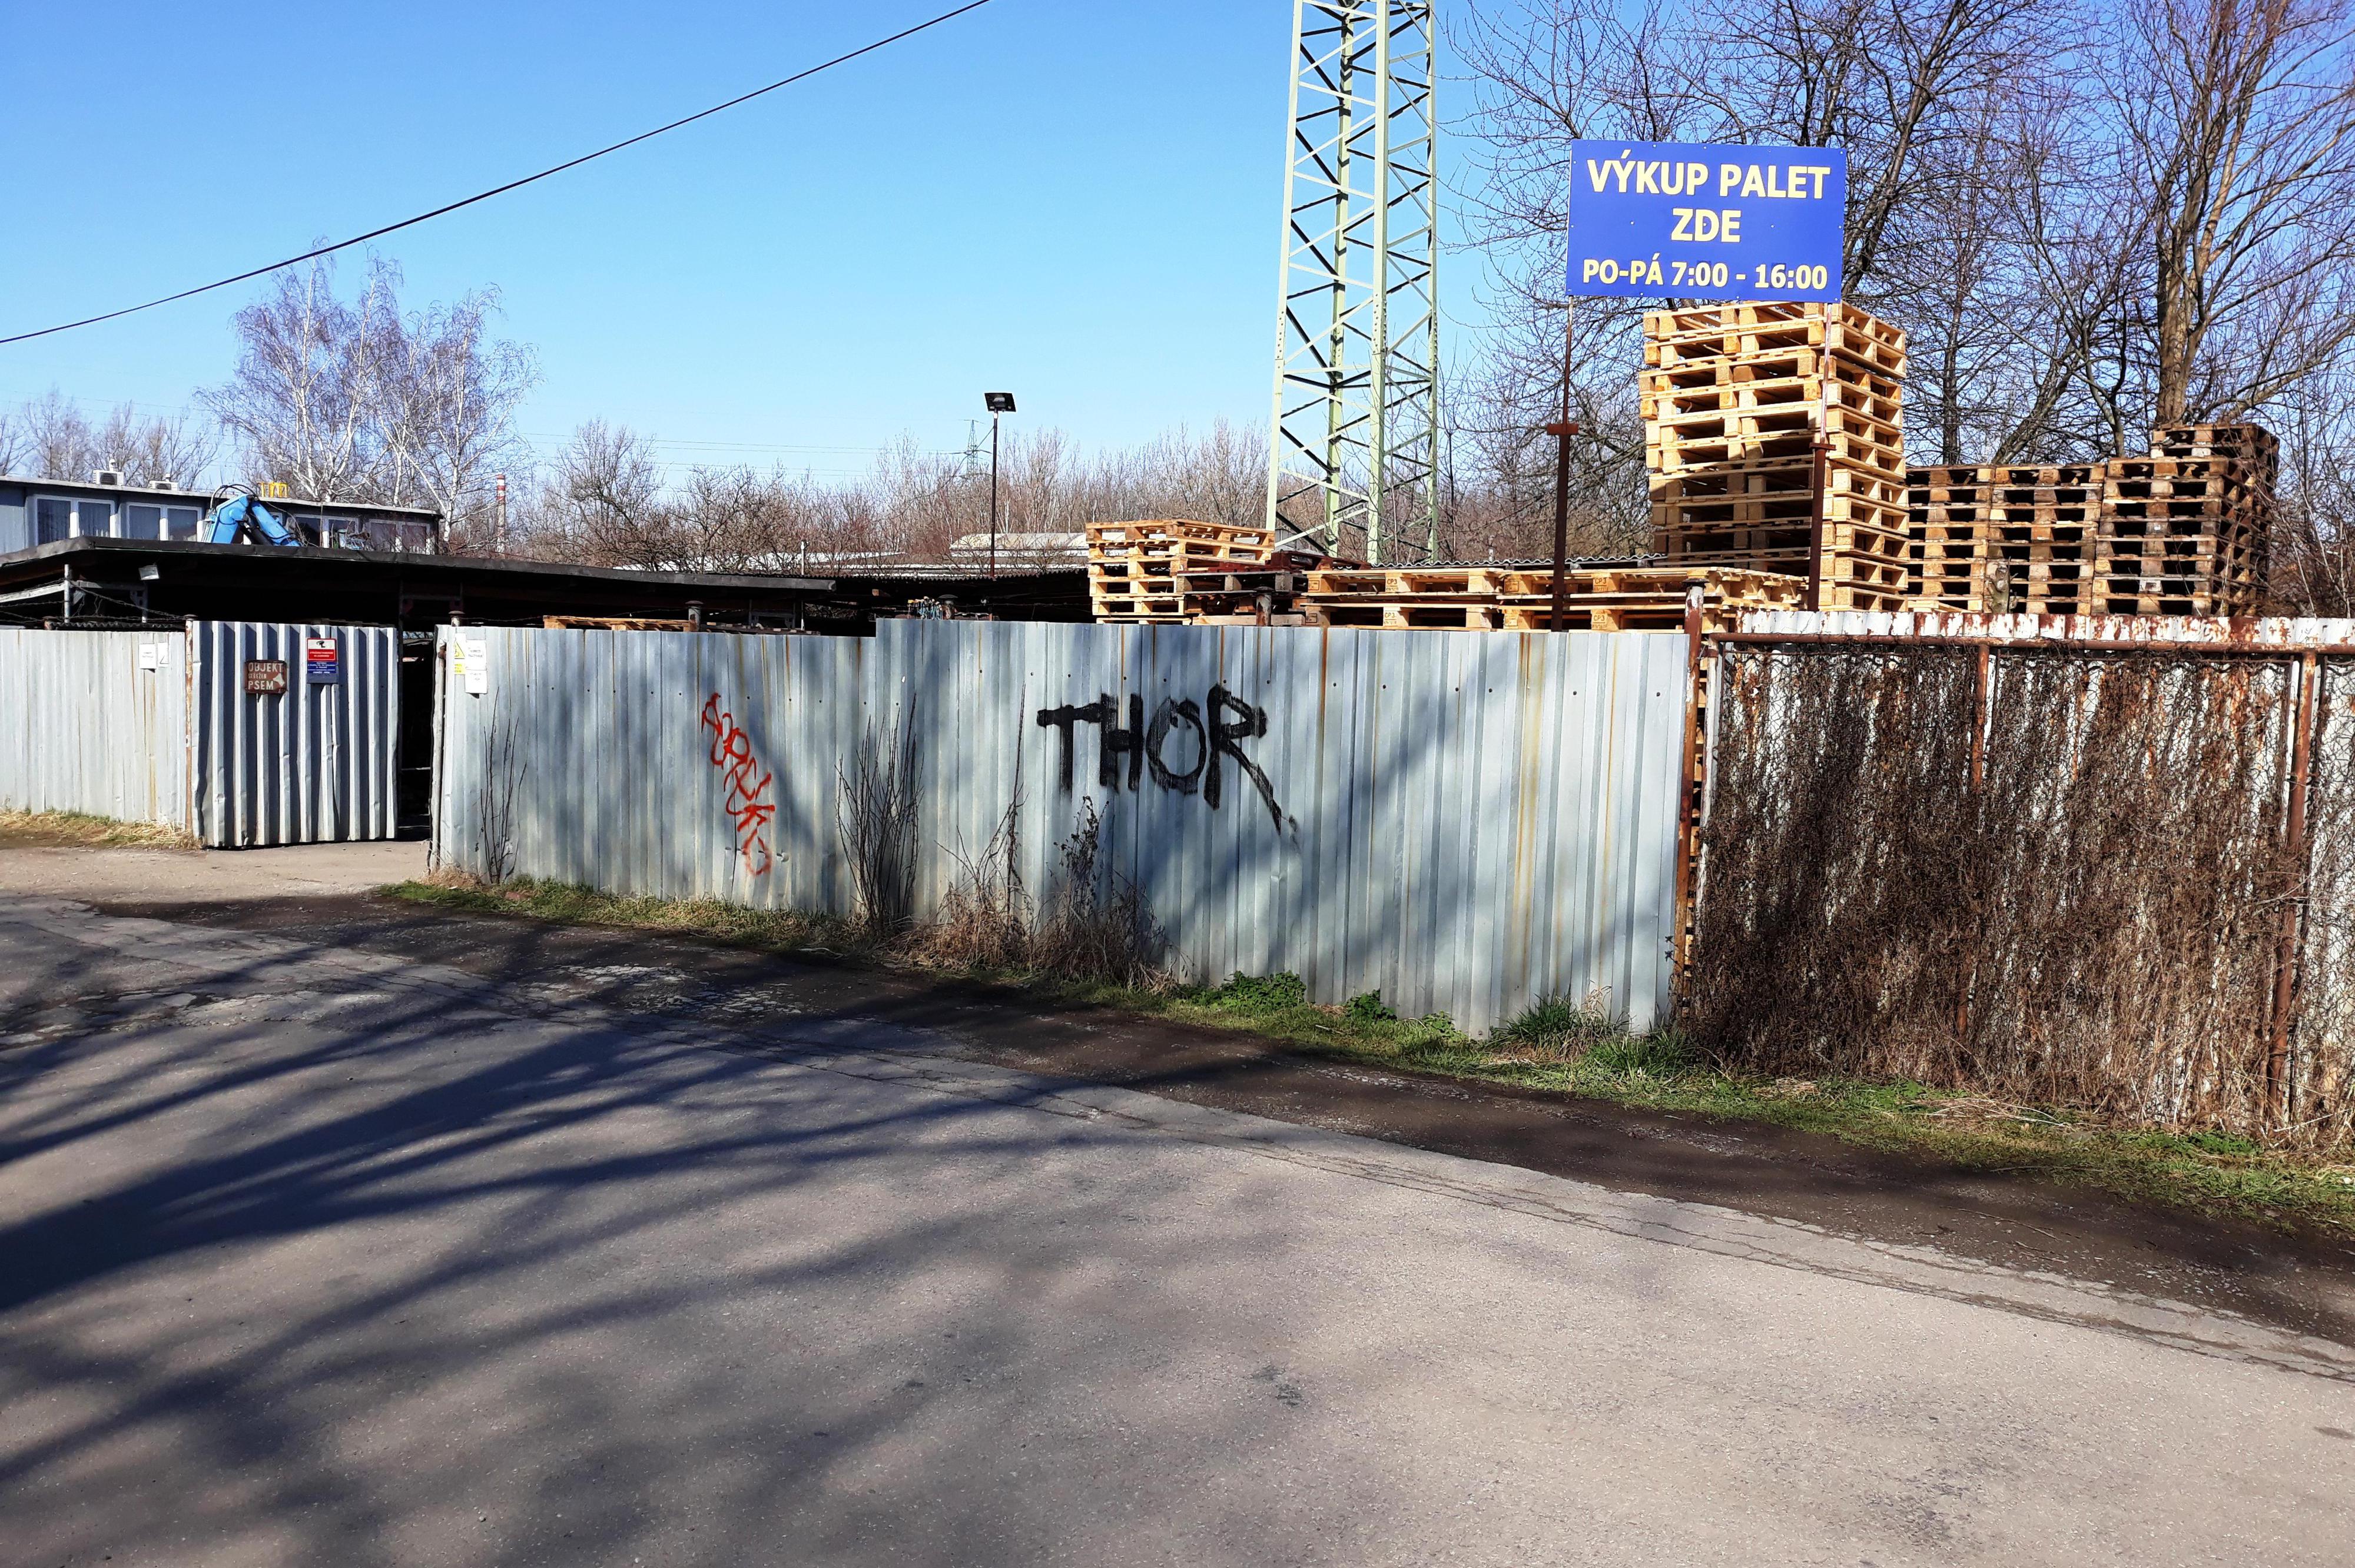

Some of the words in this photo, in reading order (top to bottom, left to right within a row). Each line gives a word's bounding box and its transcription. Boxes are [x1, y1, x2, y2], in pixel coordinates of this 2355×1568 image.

[1587, 149, 1709, 195] VÝKUP
[1719, 164, 1830, 199] PALET
[1671, 208, 1742, 242] ZDE
[1583, 253, 1663, 285] PO-PÁ
[1671, 261, 1729, 287] 7:00
[1754, 264, 1827, 290] 16:00
[248, 662, 283, 672] OBJEKT
[248, 680, 274, 690] PSEM
[1036, 683, 1288, 836] THOR
